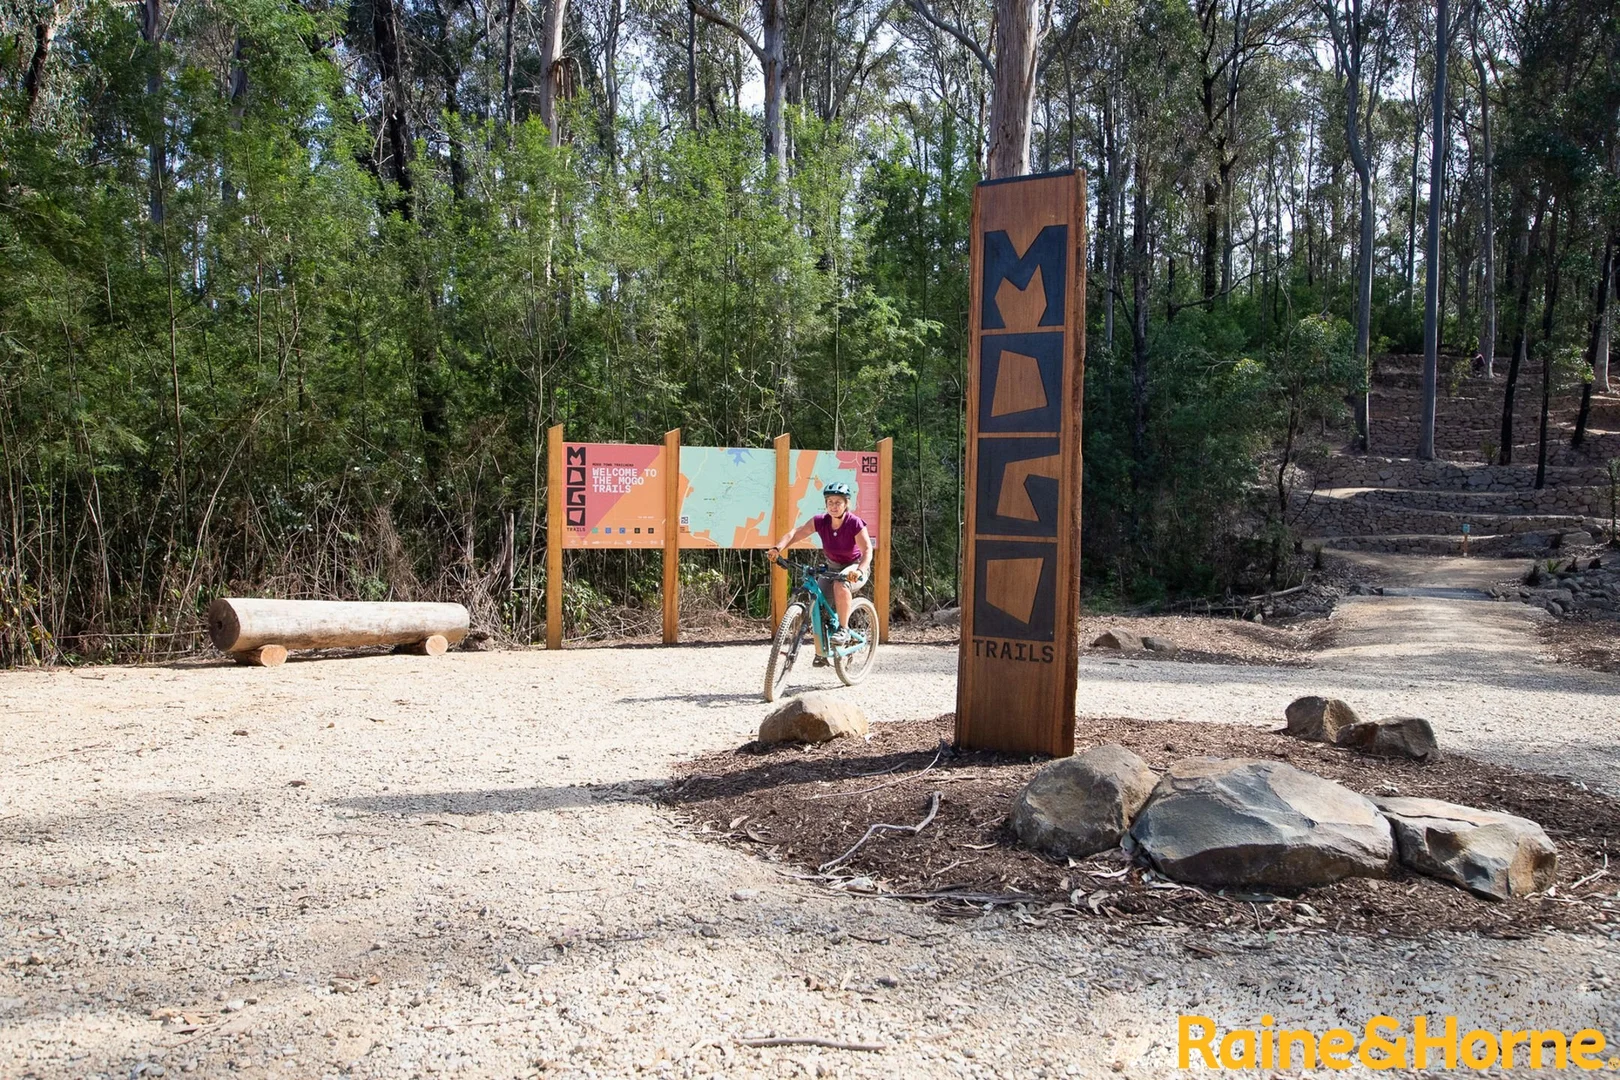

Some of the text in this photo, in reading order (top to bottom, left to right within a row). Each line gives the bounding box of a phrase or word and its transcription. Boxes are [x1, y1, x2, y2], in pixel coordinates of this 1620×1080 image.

[973, 224, 1067, 642] MOGO
[592, 467, 657, 477] WELCOME TO
[592, 476, 644, 485] THE MOGO
[567, 447, 586, 526] MOGO
[592, 484, 631, 493] TRAILS
[974, 639, 1055, 664] TRAILS
